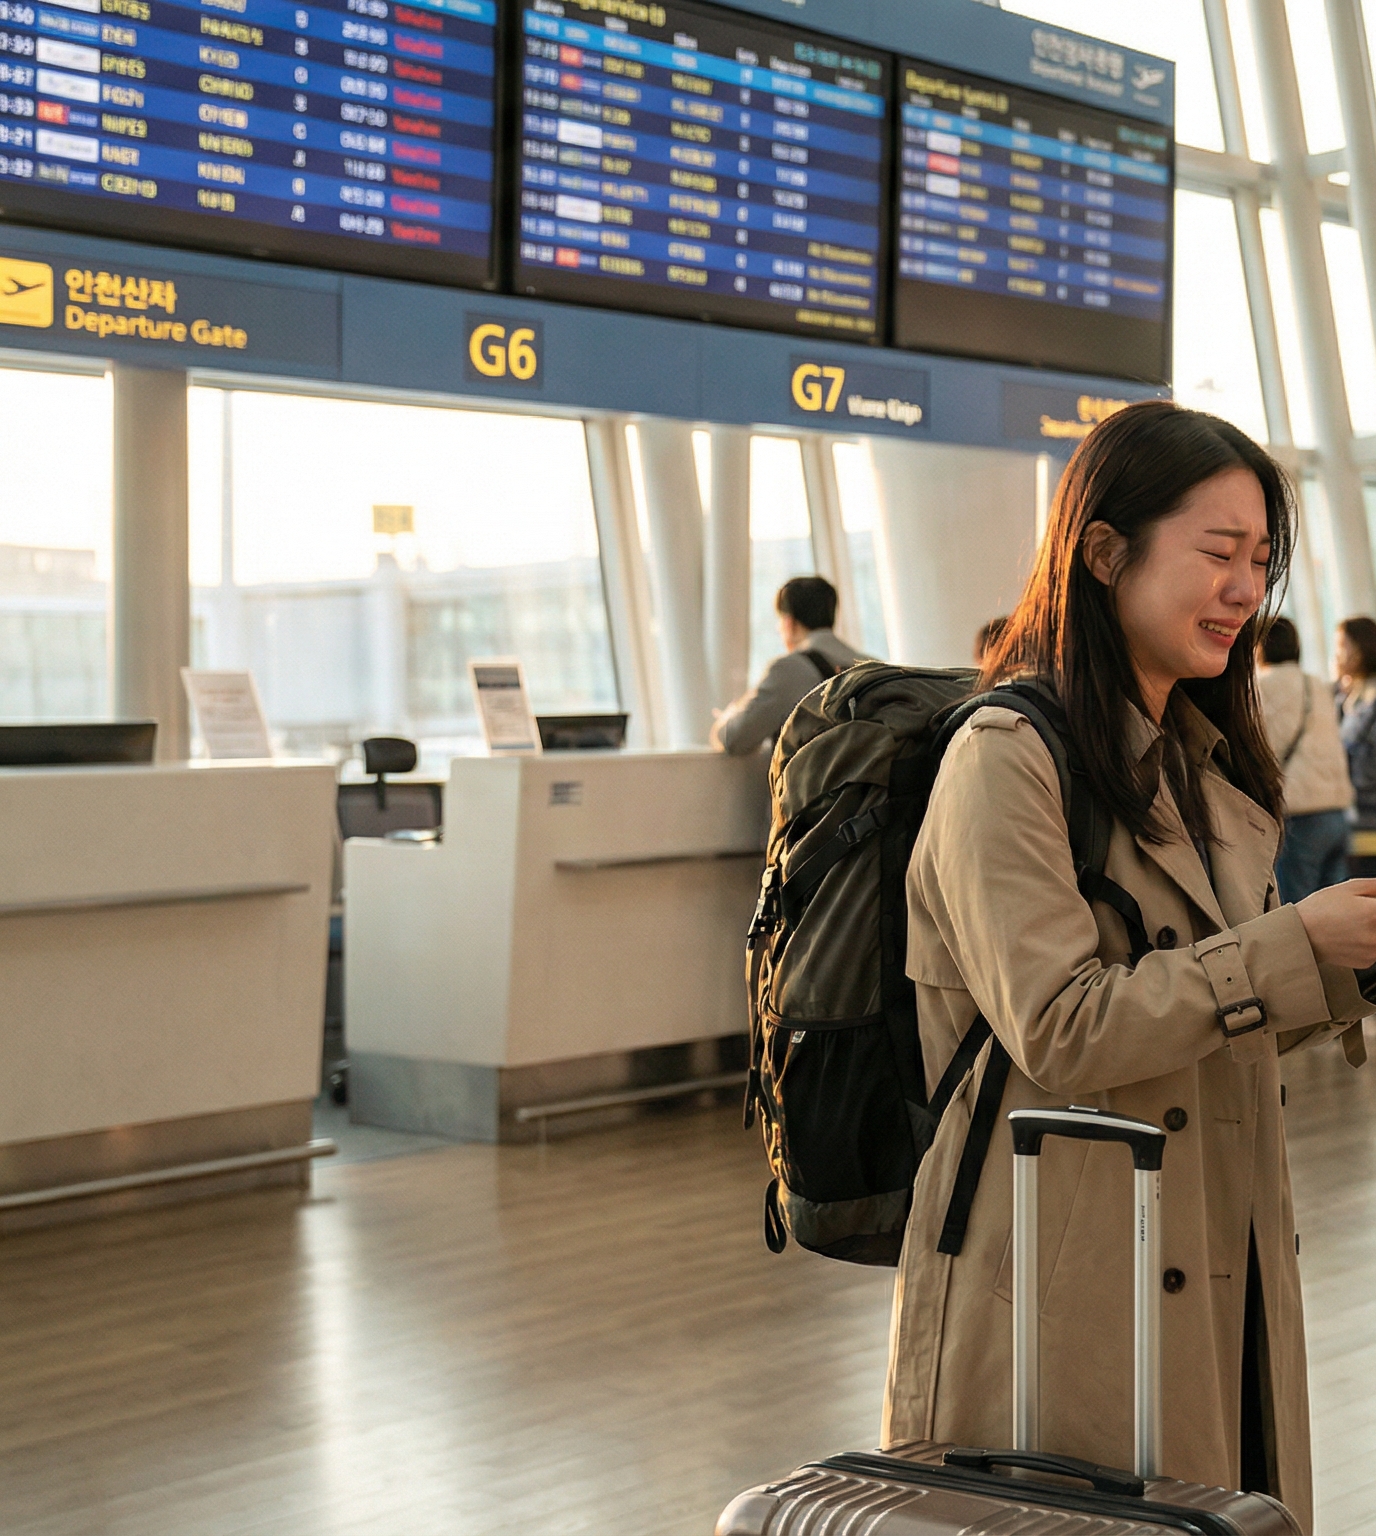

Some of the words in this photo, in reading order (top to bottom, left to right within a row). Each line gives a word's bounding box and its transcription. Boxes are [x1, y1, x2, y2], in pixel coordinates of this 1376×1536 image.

[65, 305, 187, 342] Departure
[190, 319, 248, 349] Gate
[469, 323, 537, 380] G6
[791, 363, 845, 413] G7
